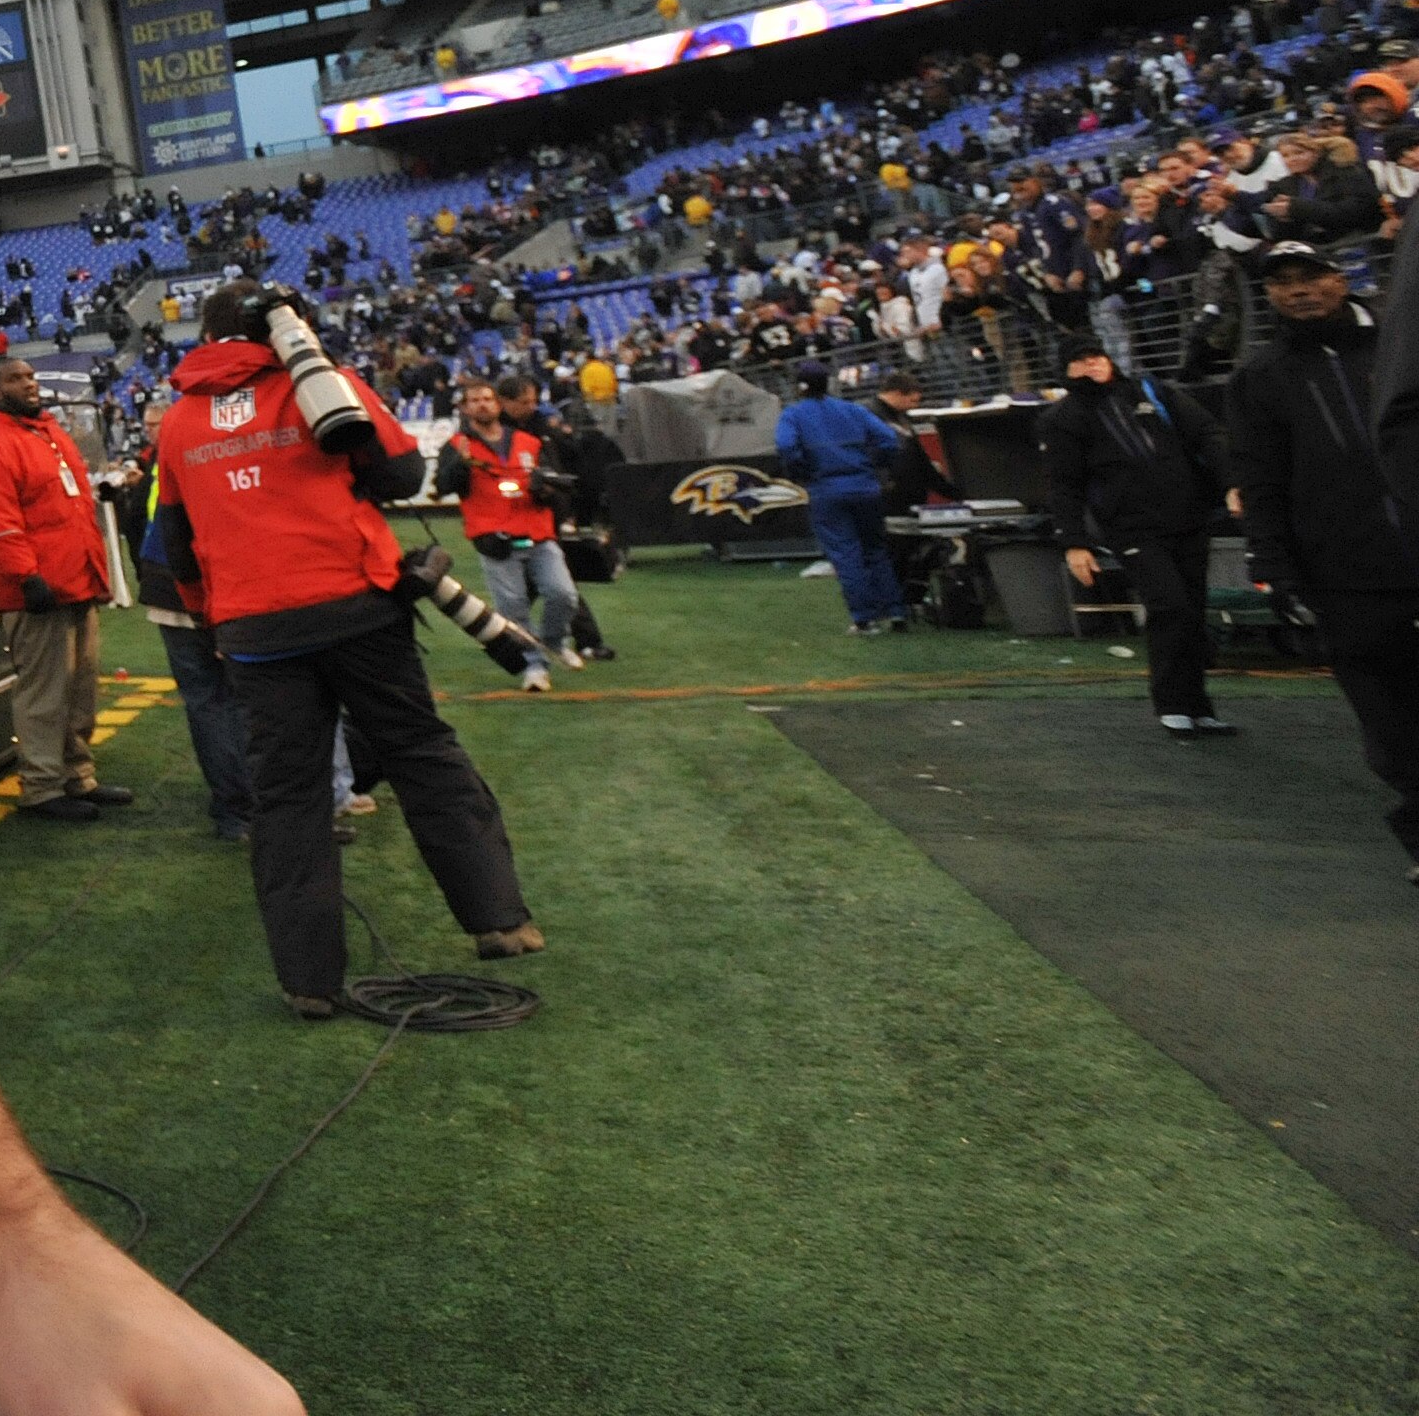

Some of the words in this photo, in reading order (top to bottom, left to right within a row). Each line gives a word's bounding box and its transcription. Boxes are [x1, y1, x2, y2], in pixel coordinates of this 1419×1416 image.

[138, 45, 228, 87] MORE
[217, 402, 254, 425] NFL
[226, 466, 261, 492] 167
